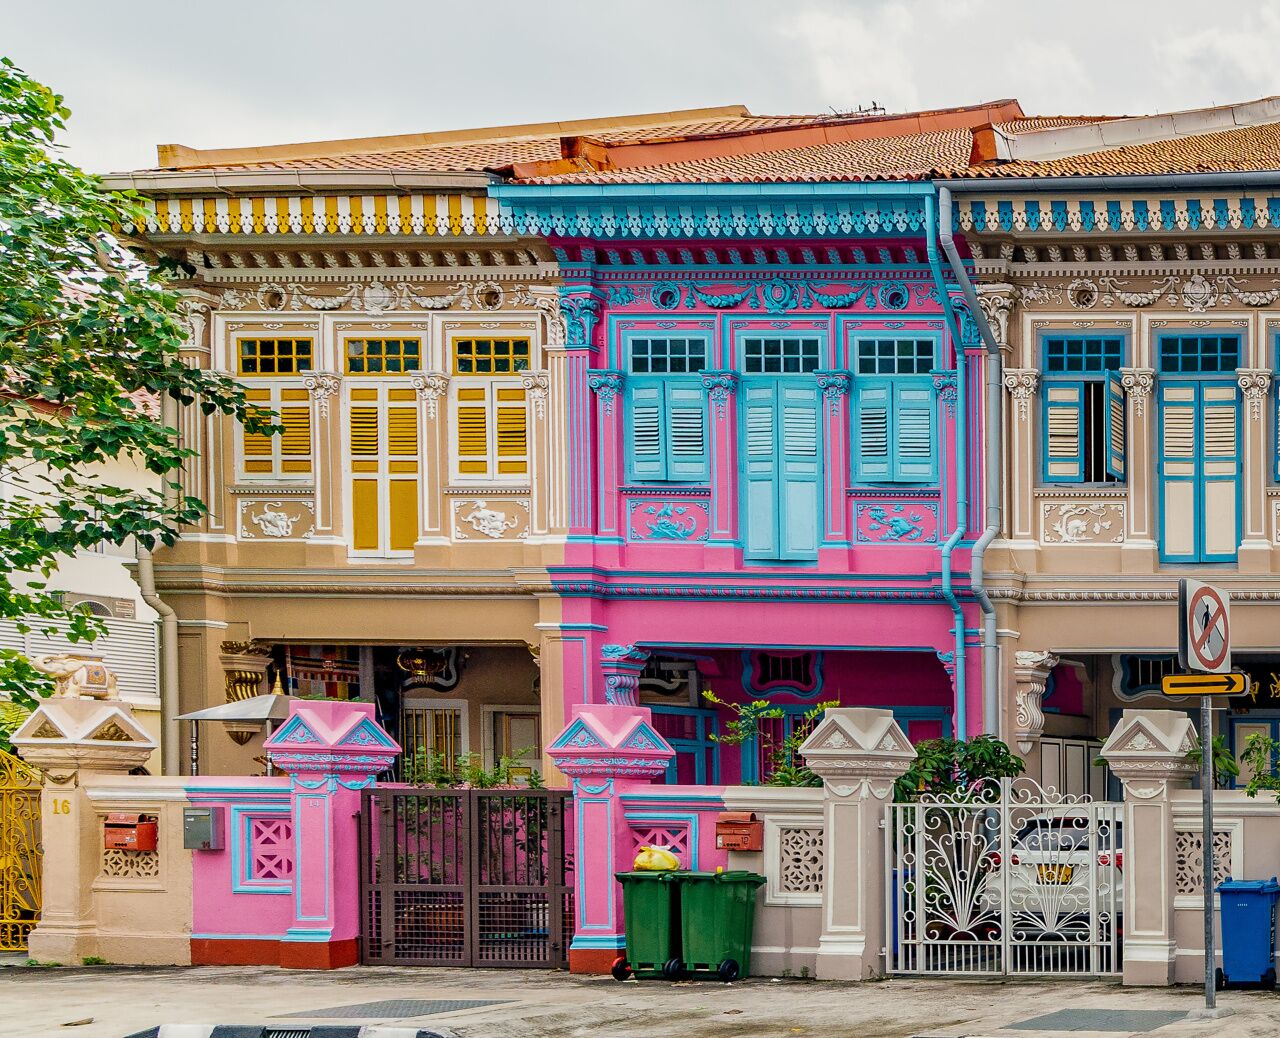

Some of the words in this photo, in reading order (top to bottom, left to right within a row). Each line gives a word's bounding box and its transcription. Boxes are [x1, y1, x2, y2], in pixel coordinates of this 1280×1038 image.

[52, 798, 71, 815] 16
[308, 799, 320, 808] 14
[740, 836, 749, 845] 12
